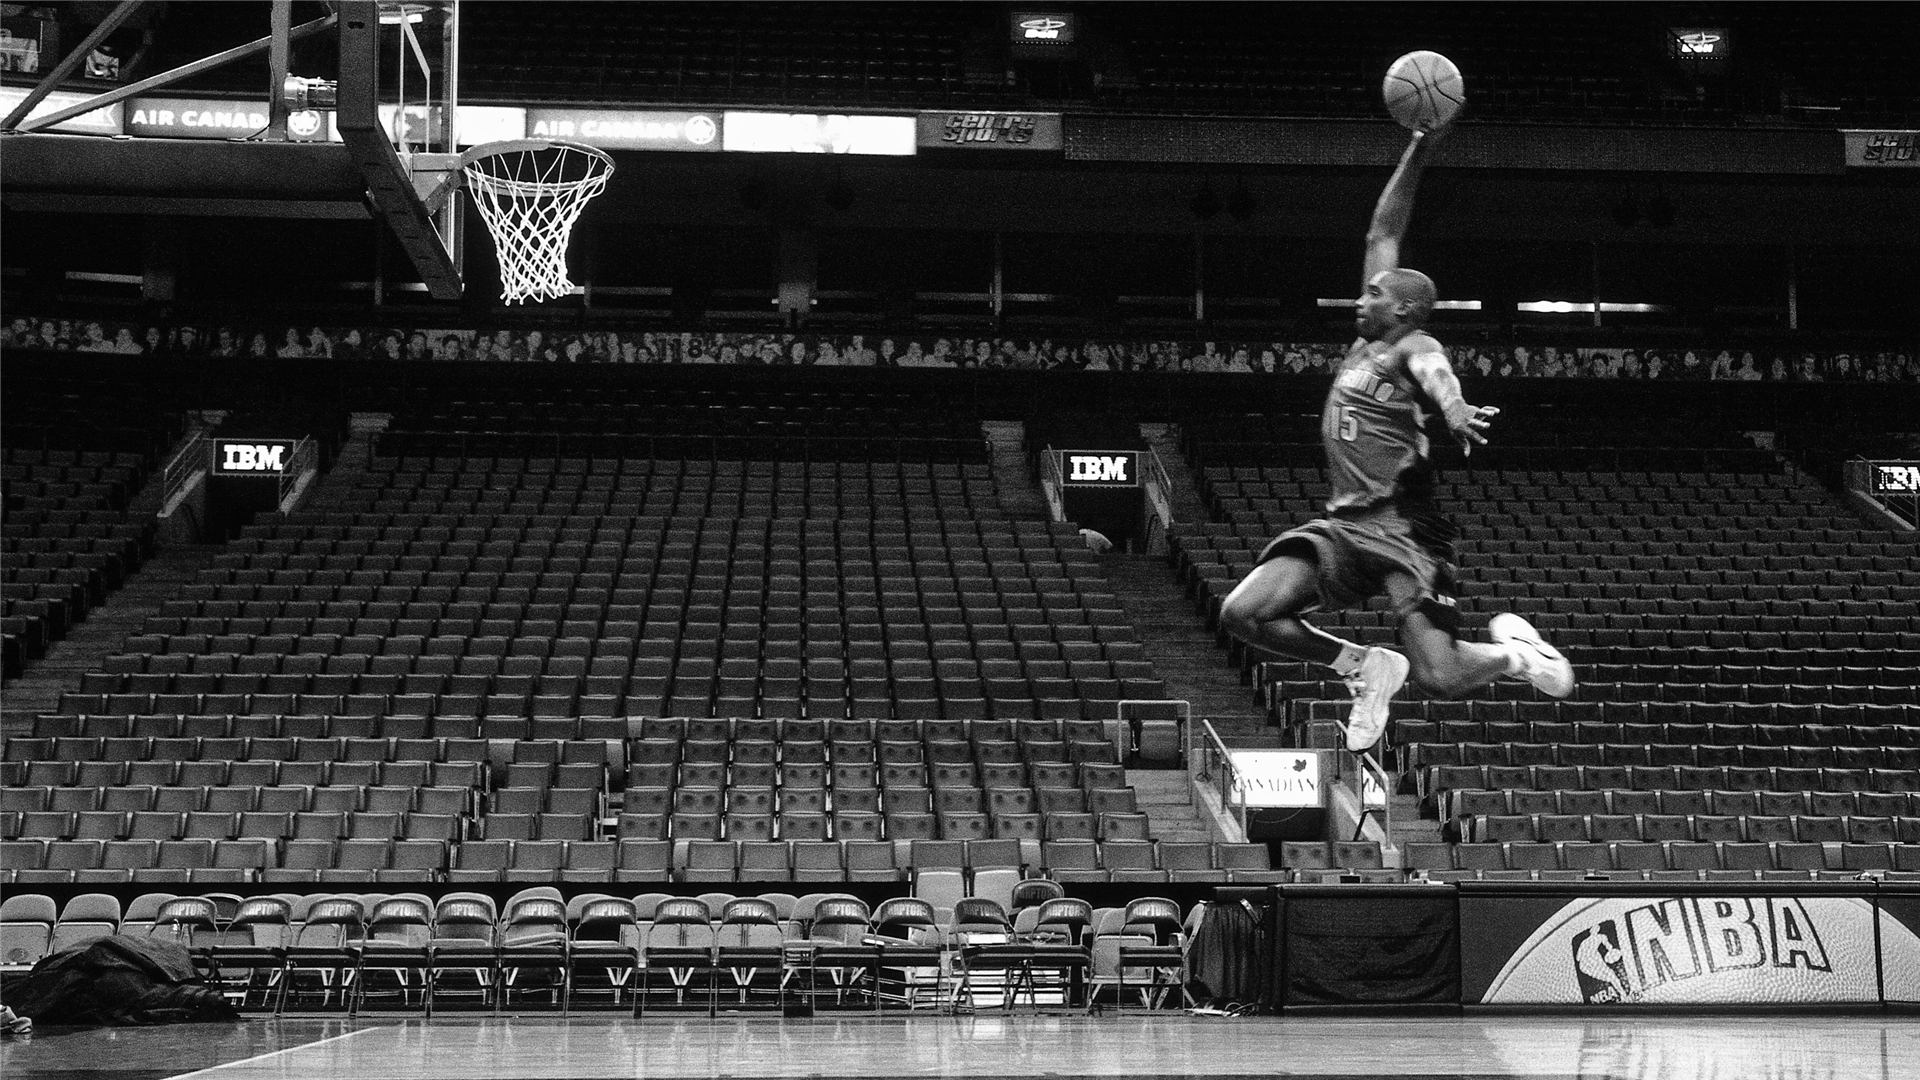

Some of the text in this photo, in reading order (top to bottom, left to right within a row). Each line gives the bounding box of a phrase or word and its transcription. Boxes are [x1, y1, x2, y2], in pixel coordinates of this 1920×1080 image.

[131, 110, 175, 126] AIR
[181, 111, 270, 129] CANAD
[533, 120, 575, 137] AIR
[1330, 404, 1358, 442] 15
[223, 444, 285, 471] IBM
[1069, 456, 1128, 481] IBM
[1624, 898, 1833, 992] NBA
[1590, 986, 1620, 1004] NBA
